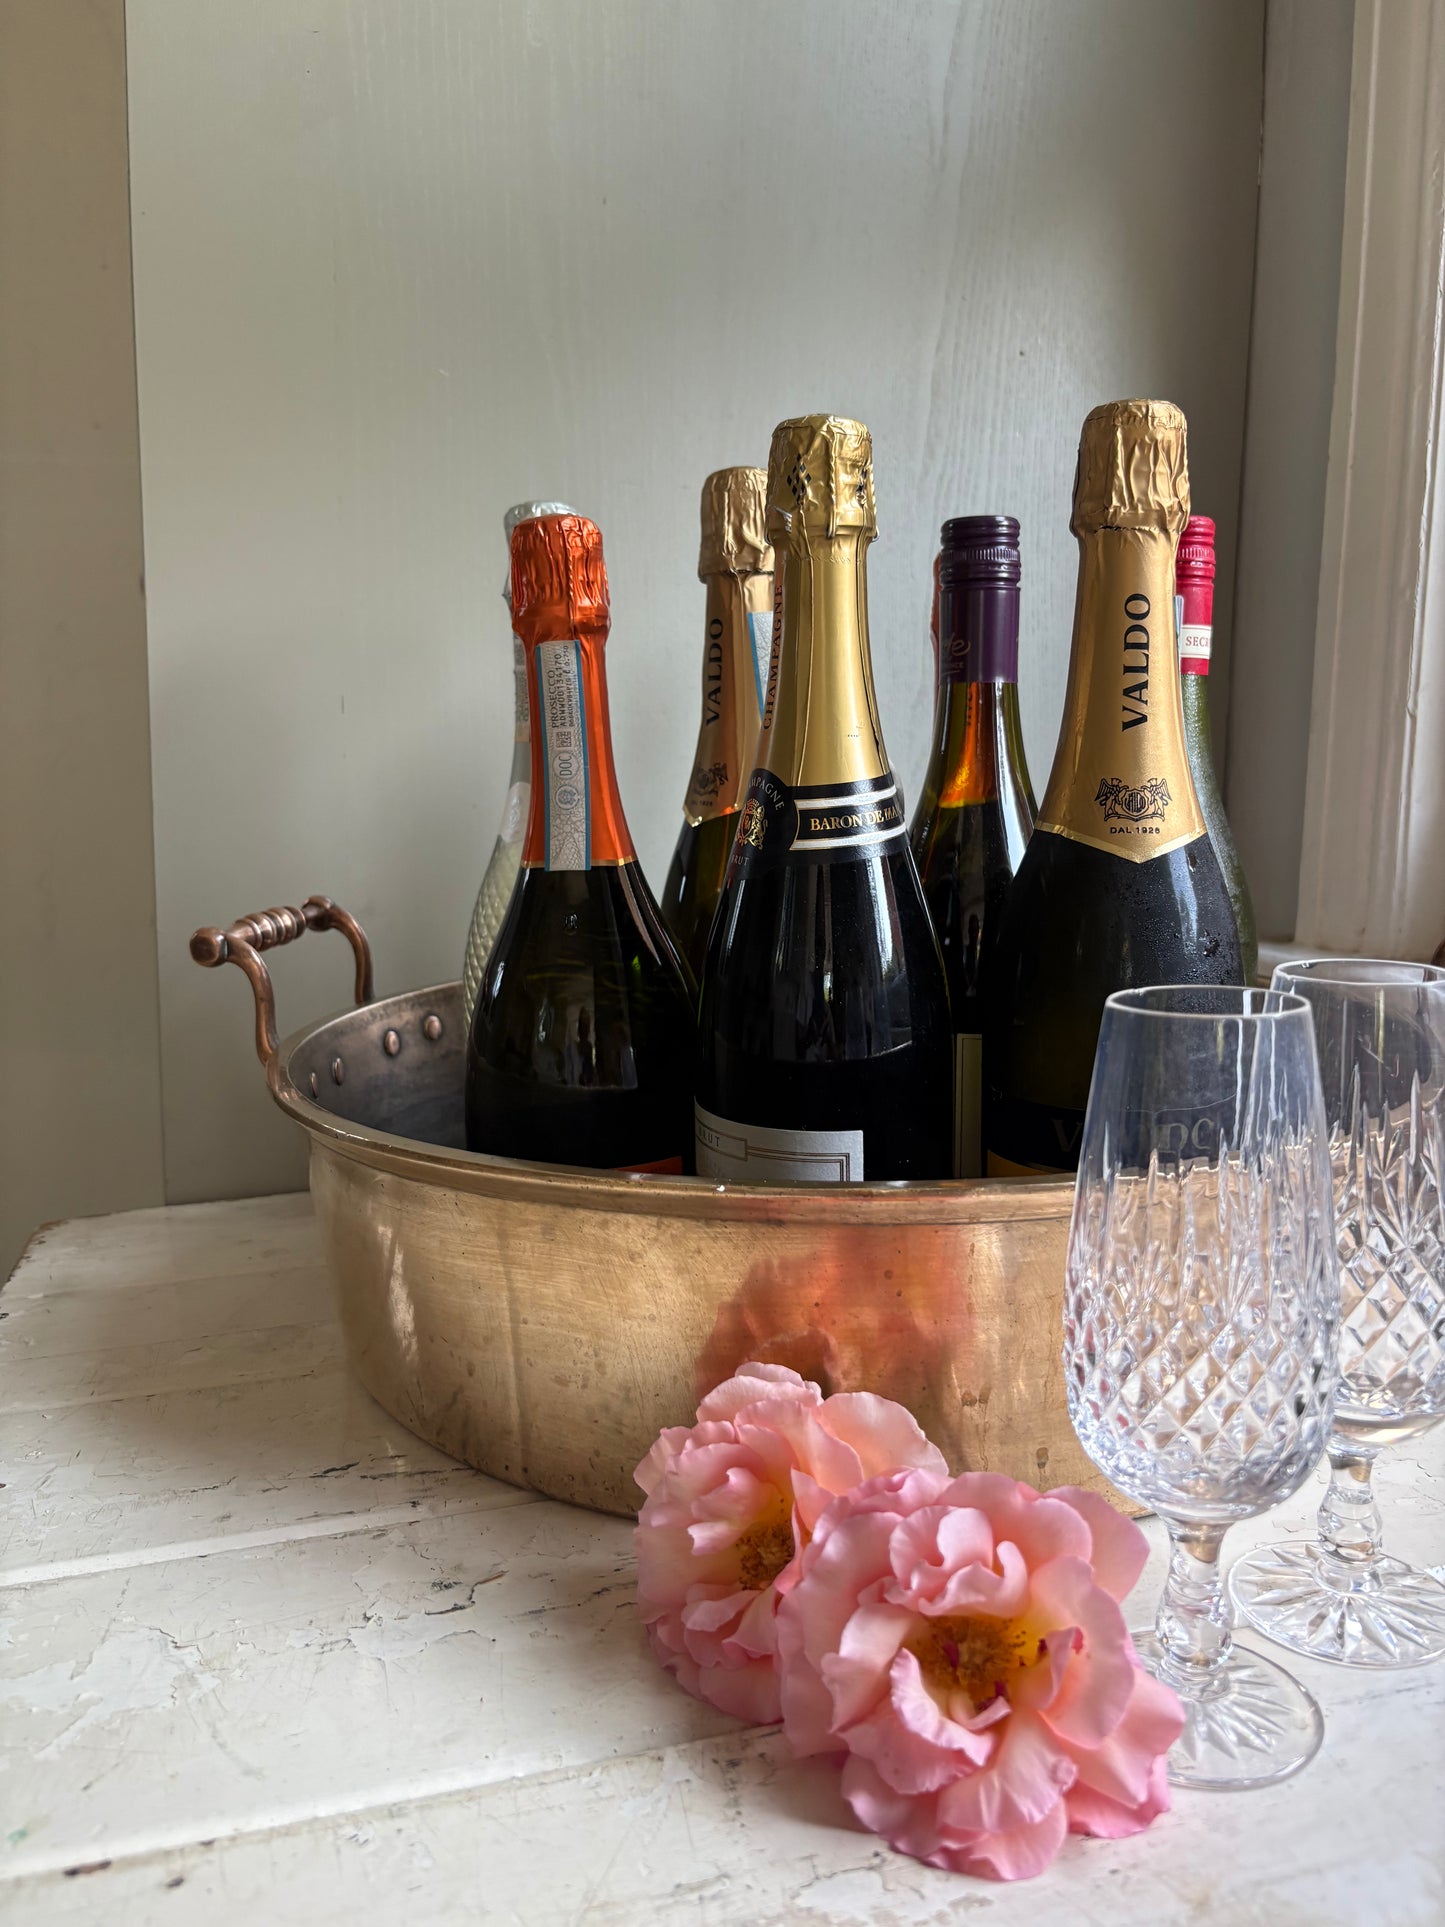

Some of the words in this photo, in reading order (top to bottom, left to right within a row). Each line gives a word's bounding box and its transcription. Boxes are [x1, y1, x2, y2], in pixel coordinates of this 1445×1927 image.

[706, 618, 724, 726] VALDO
[1121, 593, 1151, 732] VALDO
[547, 669, 560, 729] PROSECCO
[558, 755, 573, 776] DOC
[810, 814, 864, 831] BARON
[864, 809, 885, 825] DE
[1109, 826, 1133, 834] DAL
